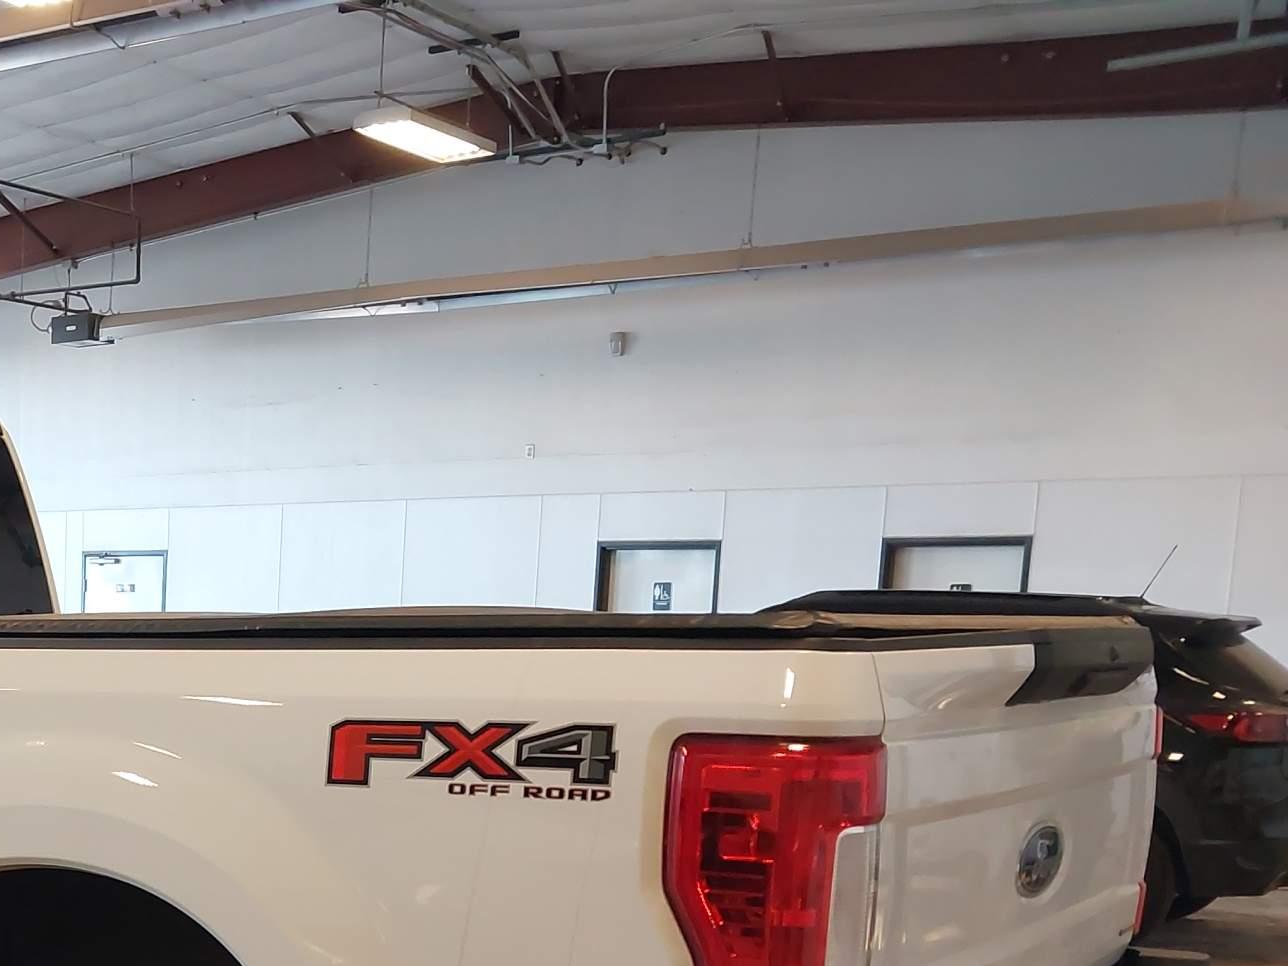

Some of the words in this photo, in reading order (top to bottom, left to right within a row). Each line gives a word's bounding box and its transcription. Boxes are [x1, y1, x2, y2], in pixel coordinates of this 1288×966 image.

[326, 720, 617, 785] FX4
[448, 783, 511, 797] OFF
[523, 786, 611, 801] ROAD
